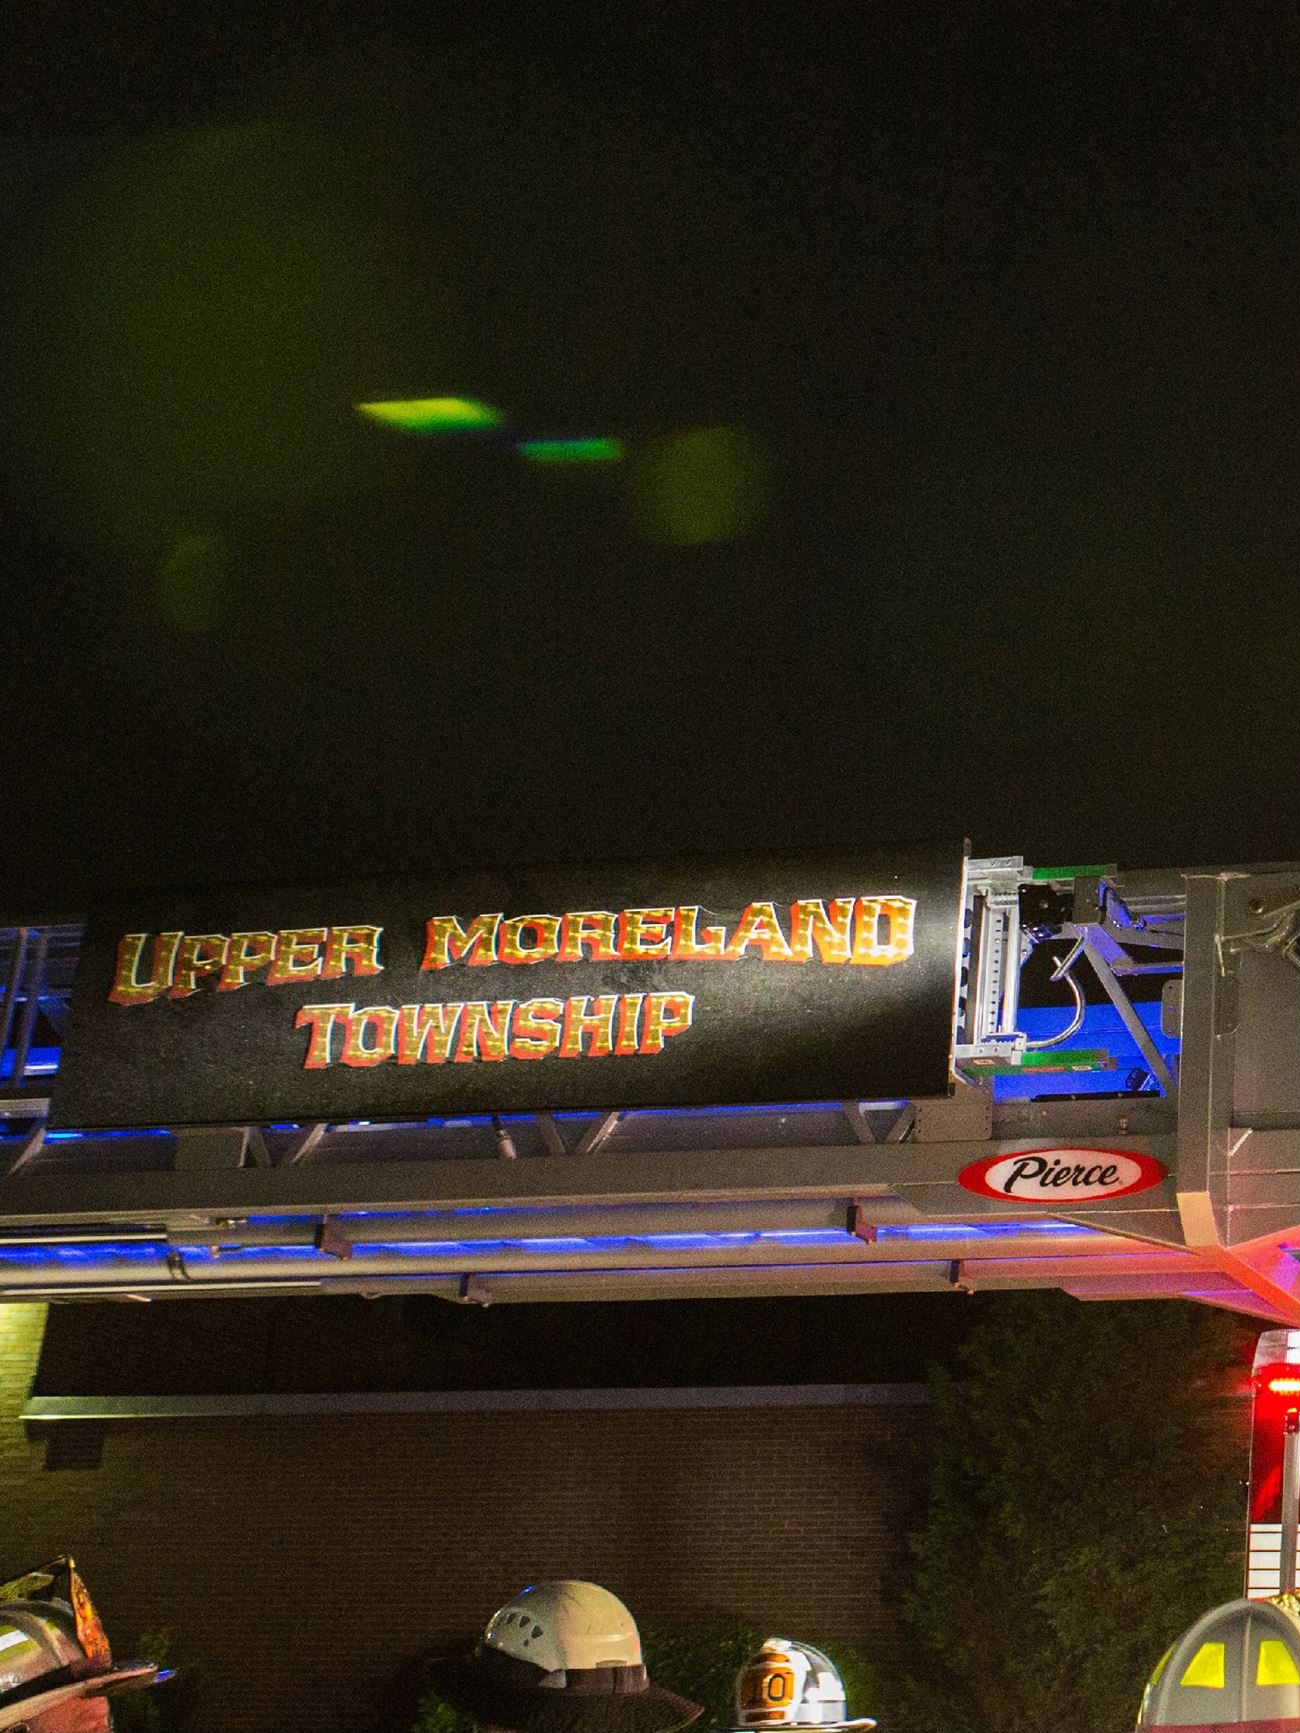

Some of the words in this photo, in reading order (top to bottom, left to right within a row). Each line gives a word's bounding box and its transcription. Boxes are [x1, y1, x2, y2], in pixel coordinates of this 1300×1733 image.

[108, 925, 384, 1005] UPPER
[420, 895, 917, 970] MORELAND
[294, 991, 695, 1069] TOWNSHIP
[1003, 1156, 1120, 1193] Pierce
